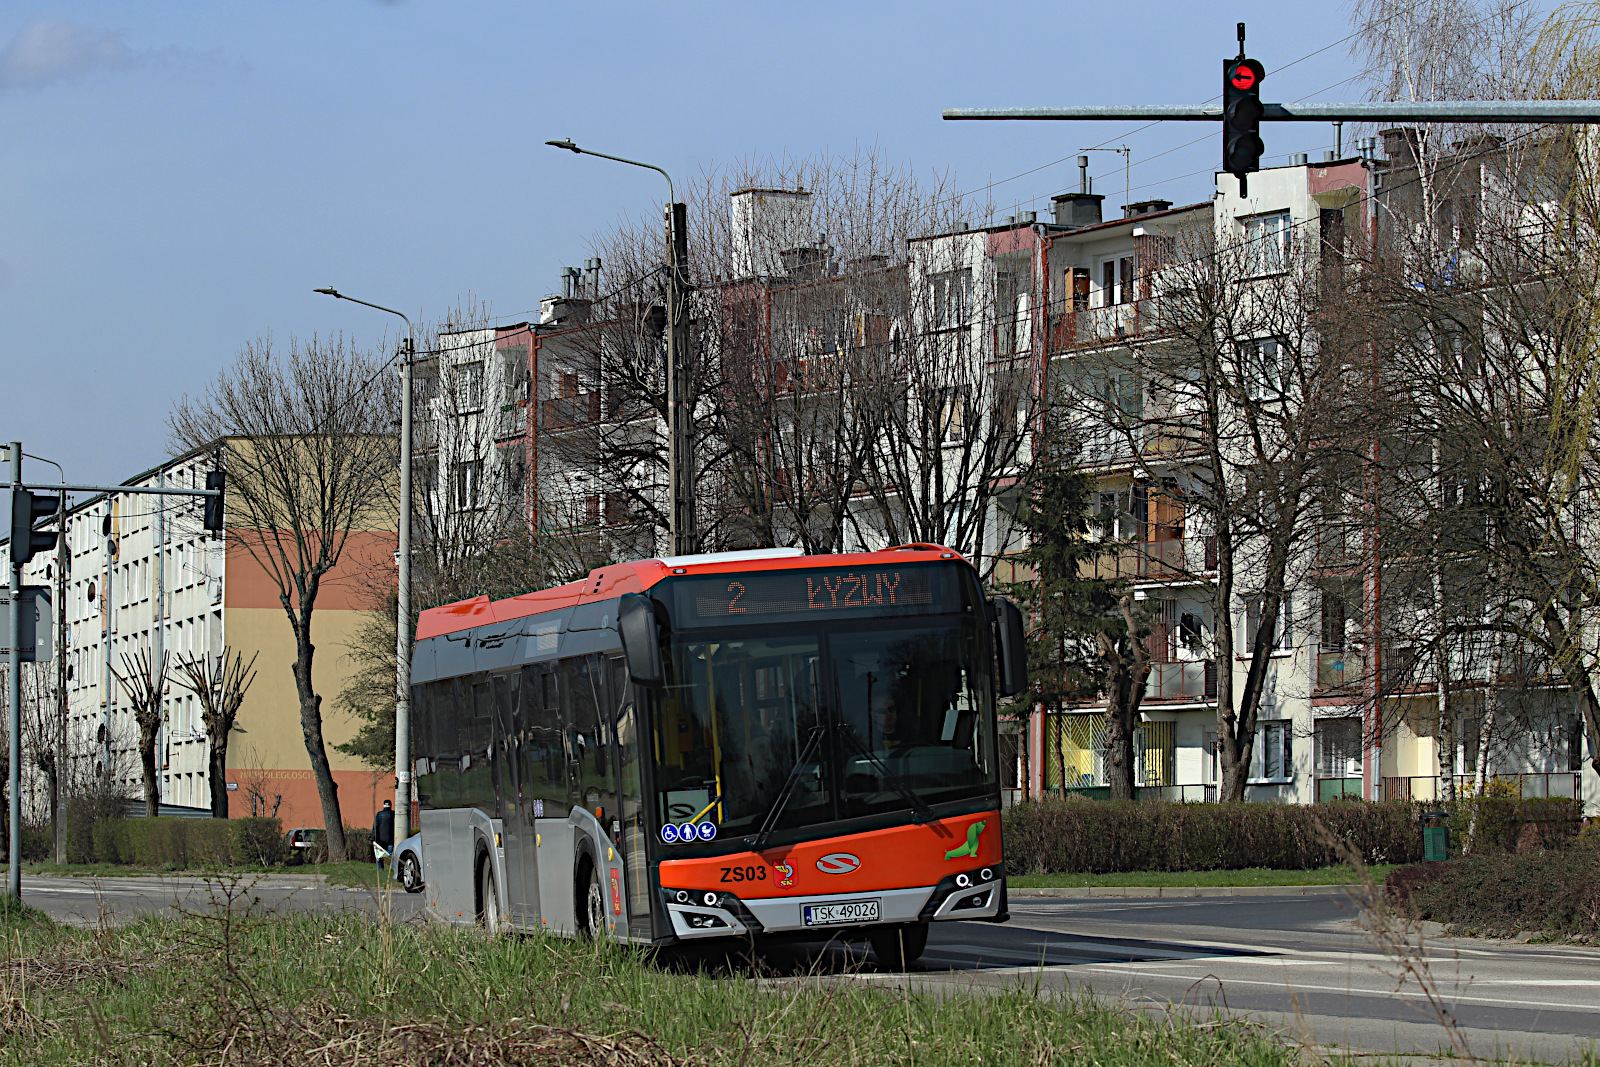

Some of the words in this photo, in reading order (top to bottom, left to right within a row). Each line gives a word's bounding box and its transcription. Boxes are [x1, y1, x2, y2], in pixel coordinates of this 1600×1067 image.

[727, 581, 746, 613] 2
[807, 573, 900, 609] ŁYŻWY
[720, 865, 767, 883] ZS03
[812, 906, 835, 920] TSK
[839, 902, 876, 918] 49026
